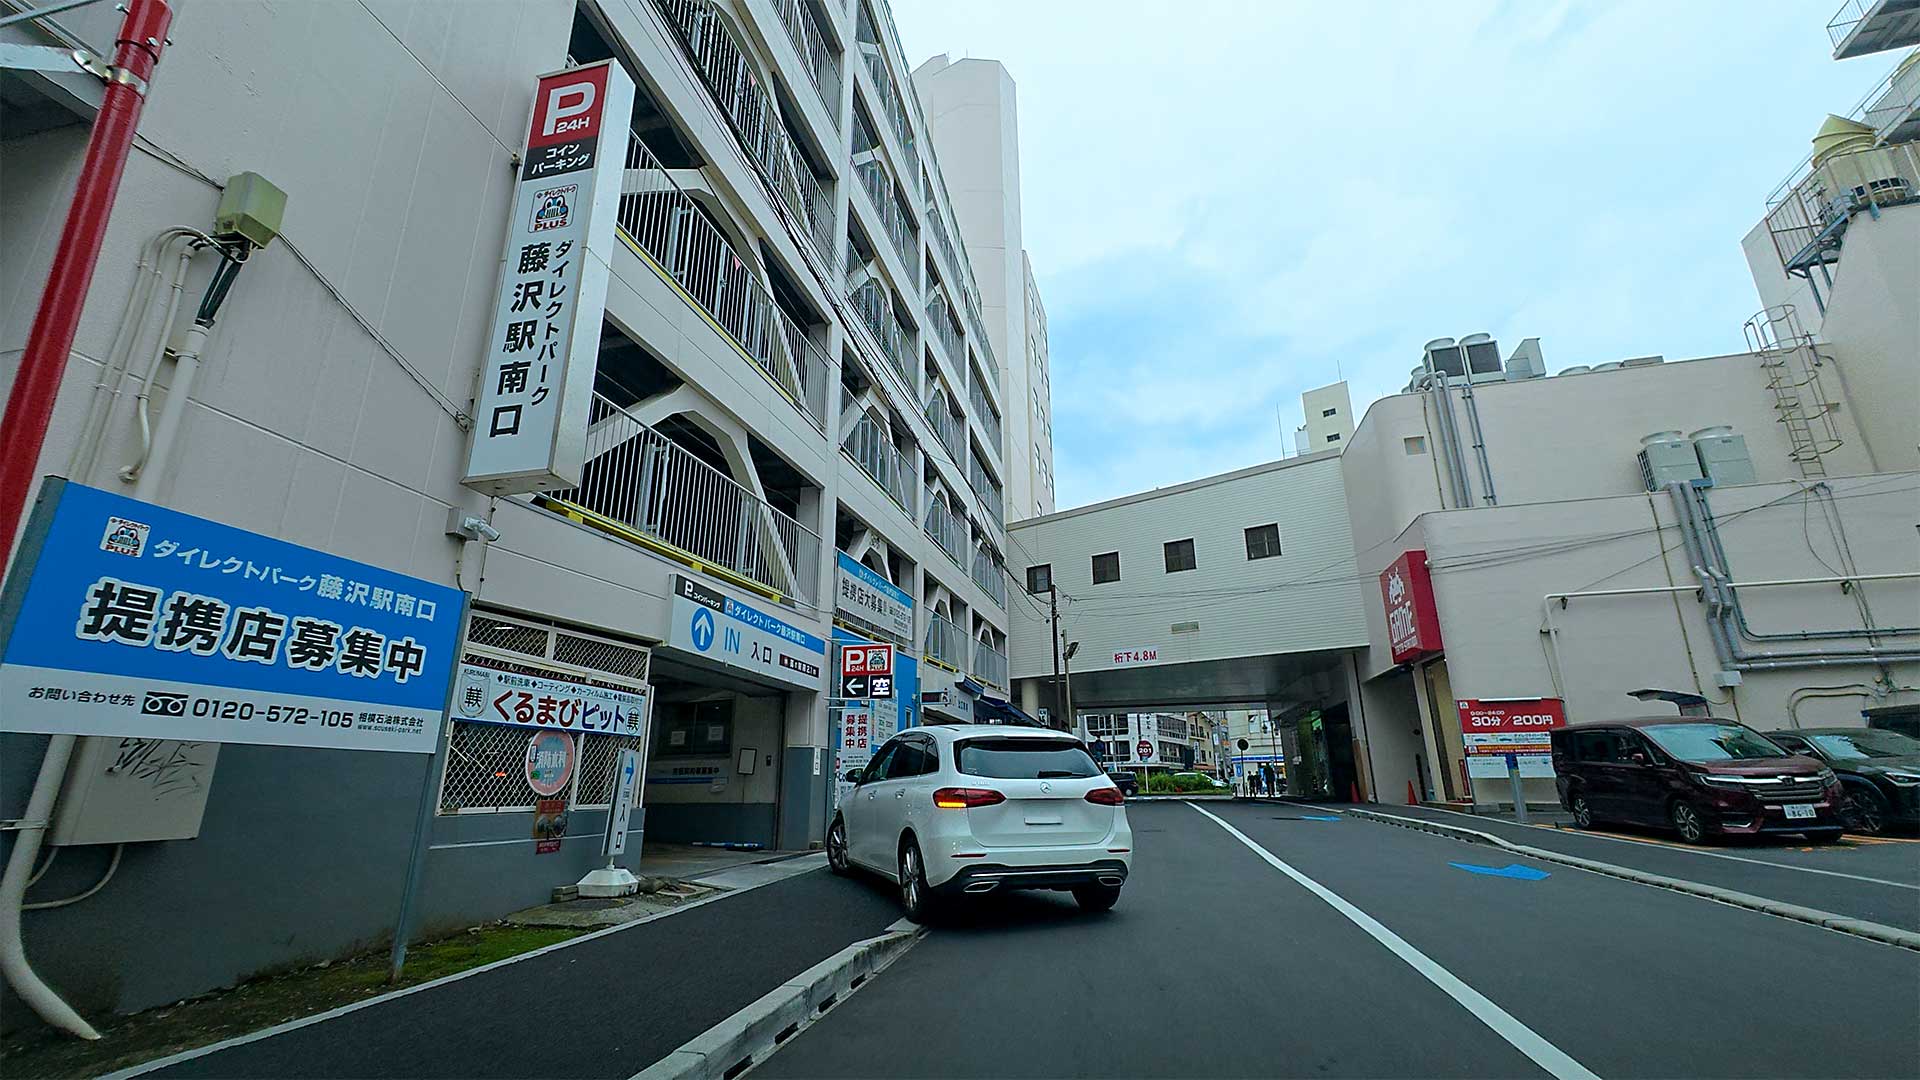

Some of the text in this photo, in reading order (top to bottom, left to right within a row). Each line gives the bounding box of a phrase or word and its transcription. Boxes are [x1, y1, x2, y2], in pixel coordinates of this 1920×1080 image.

[542, 82, 596, 136] P 24H
[546, 144, 580, 159] コイン
[531, 153, 590, 175] パーキング
[534, 219, 567, 231] PLUS
[531, 240, 574, 406] ダイレクトパーク
[489, 242, 551, 438] 藤沢駅南口
[105, 544, 138, 557] PLUS
[684, 581, 694, 597] P
[693, 593, 721, 609] コインパーキング
[78, 578, 425, 684] 提携店募集中
[724, 626, 741, 655] IN
[751, 642, 772, 665] 入口
[845, 650, 865, 672] P
[28, 687, 136, 707] お問い合わせ先
[872, 678, 890, 696] 空
[193, 698, 354, 728] 0120-572-105
[359, 712, 424, 728] 相模石油株式会社
[492, 690, 625, 732] くるまびピット
[845, 714, 856, 749] 募集中
[615, 803, 625, 848] 入口
